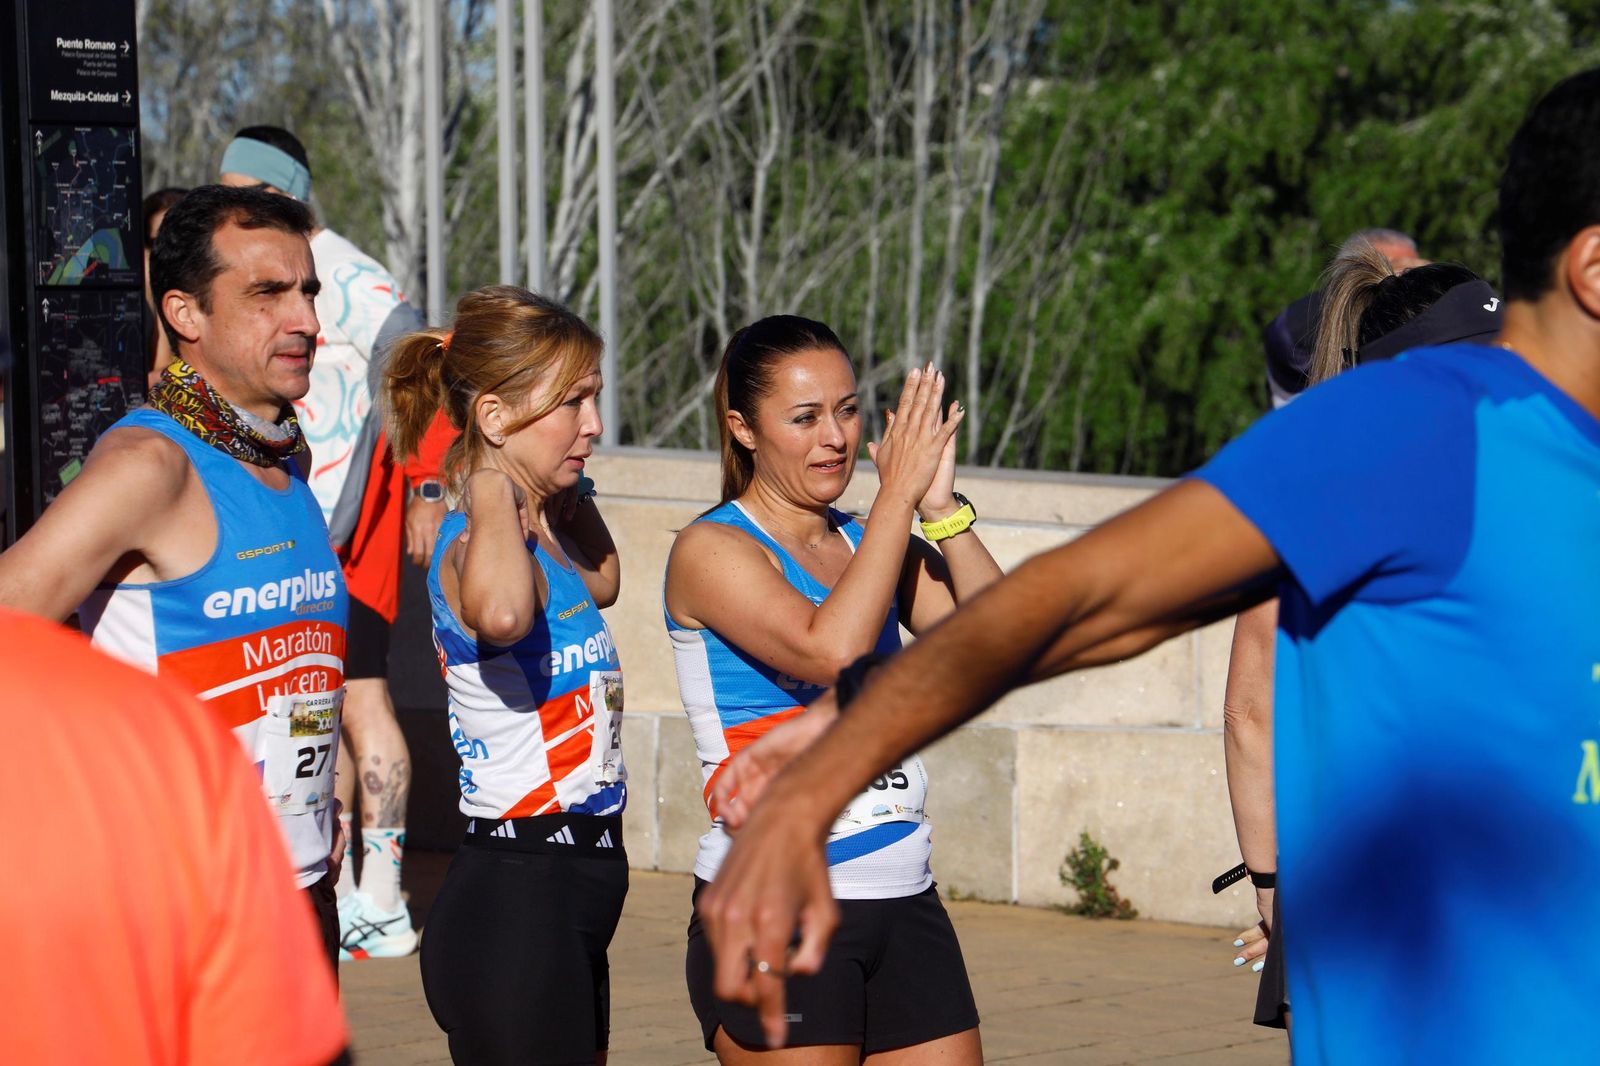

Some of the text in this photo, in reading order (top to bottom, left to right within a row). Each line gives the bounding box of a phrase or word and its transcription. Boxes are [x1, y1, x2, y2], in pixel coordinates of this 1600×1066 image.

[56, 37, 116, 50] Puente Romano
[50, 89, 119, 103] Mezquita-Catedral
[236, 542, 286, 561] GSPORT
[203, 568, 337, 619] enerplus
[295, 599, 335, 616] directo
[242, 623, 332, 670] Maratón
